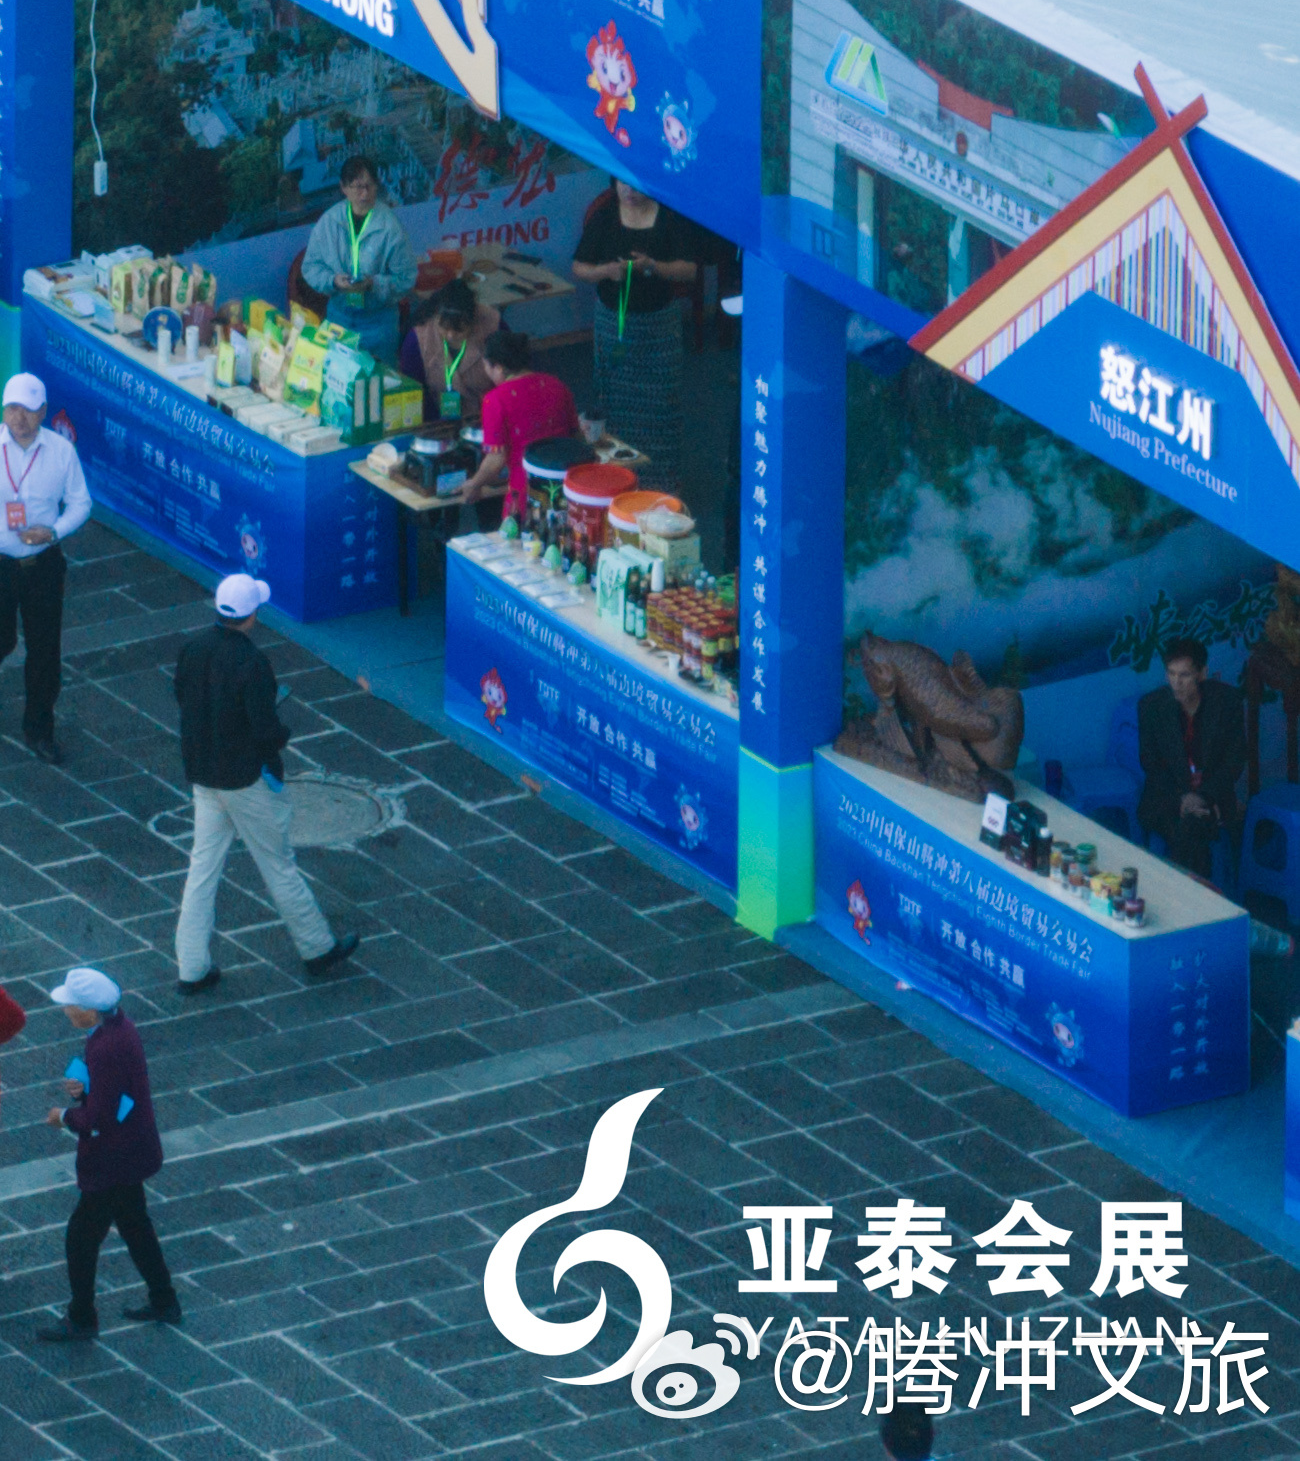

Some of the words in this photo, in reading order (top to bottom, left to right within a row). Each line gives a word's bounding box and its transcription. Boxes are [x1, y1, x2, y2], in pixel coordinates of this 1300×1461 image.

[441, 216, 549, 247] EHONG
[753, 374, 769, 534] 相聚魅力腾冲
[1089, 400, 1150, 459] Nujiang
[1154, 436, 1238, 503] Prefecture
[1100, 345, 1211, 460] 怒江州
[143, 442, 166, 470] 开放
[170, 458, 193, 484] 合作
[197, 473, 221, 502] 共赢
[752, 555, 767, 715] 共谋合作发展
[576, 706, 600, 735] 开放
[604, 723, 628, 752] 合作
[632, 740, 657, 770] 共赢
[838, 795, 1093, 963] 2023中国保山腾冲第八届边境贸易交易会
[940, 919, 966, 950] 开放
[970, 939, 995, 968] 合作
[999, 956, 1025, 989] 共赢
